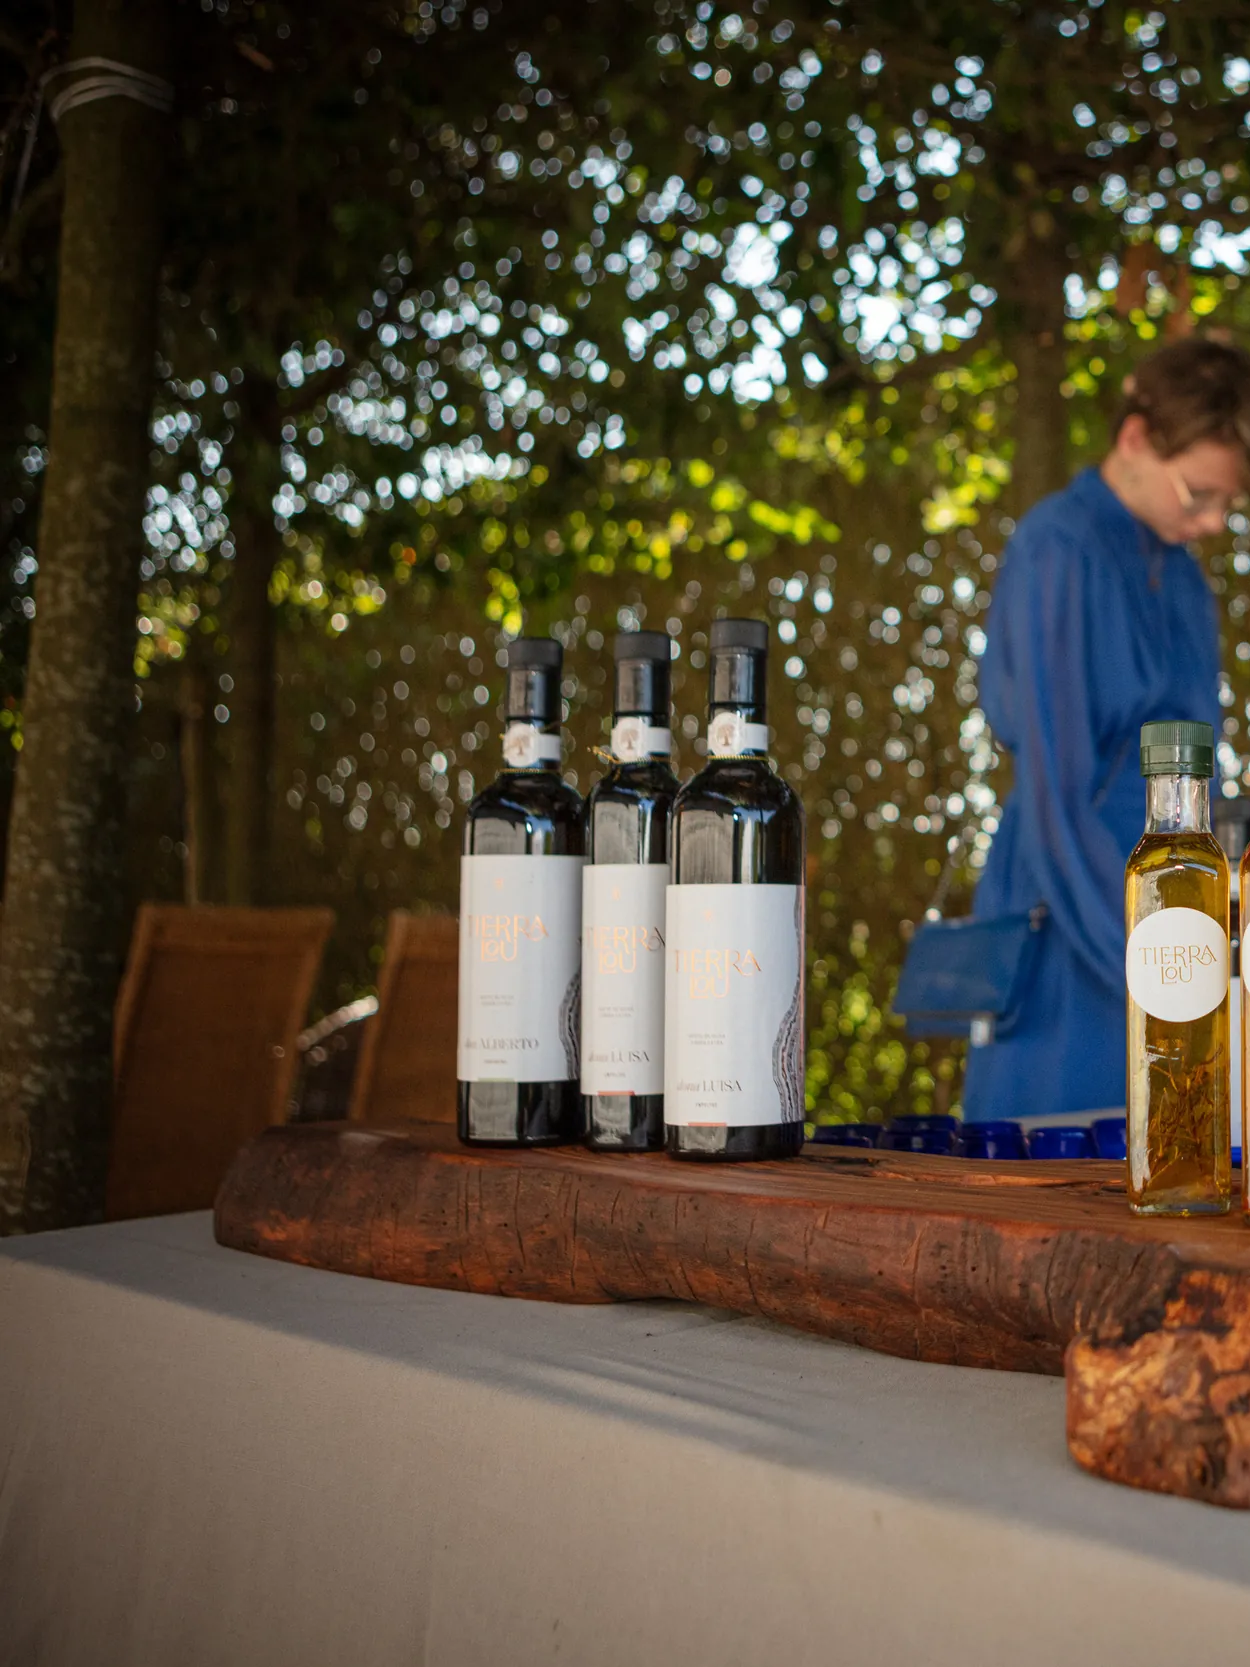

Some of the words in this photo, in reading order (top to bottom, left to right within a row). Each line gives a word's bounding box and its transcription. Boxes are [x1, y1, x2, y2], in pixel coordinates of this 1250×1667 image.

[467, 913, 549, 943] TIERRA
[584, 925, 667, 953] TIERRA
[674, 948, 762, 979] TIERRA
[1138, 944, 1217, 968] TIERRA
[480, 1037, 540, 1051] ALBERTO
[610, 1050, 651, 1063] LUISA
[702, 1079, 743, 1092] LUISA
